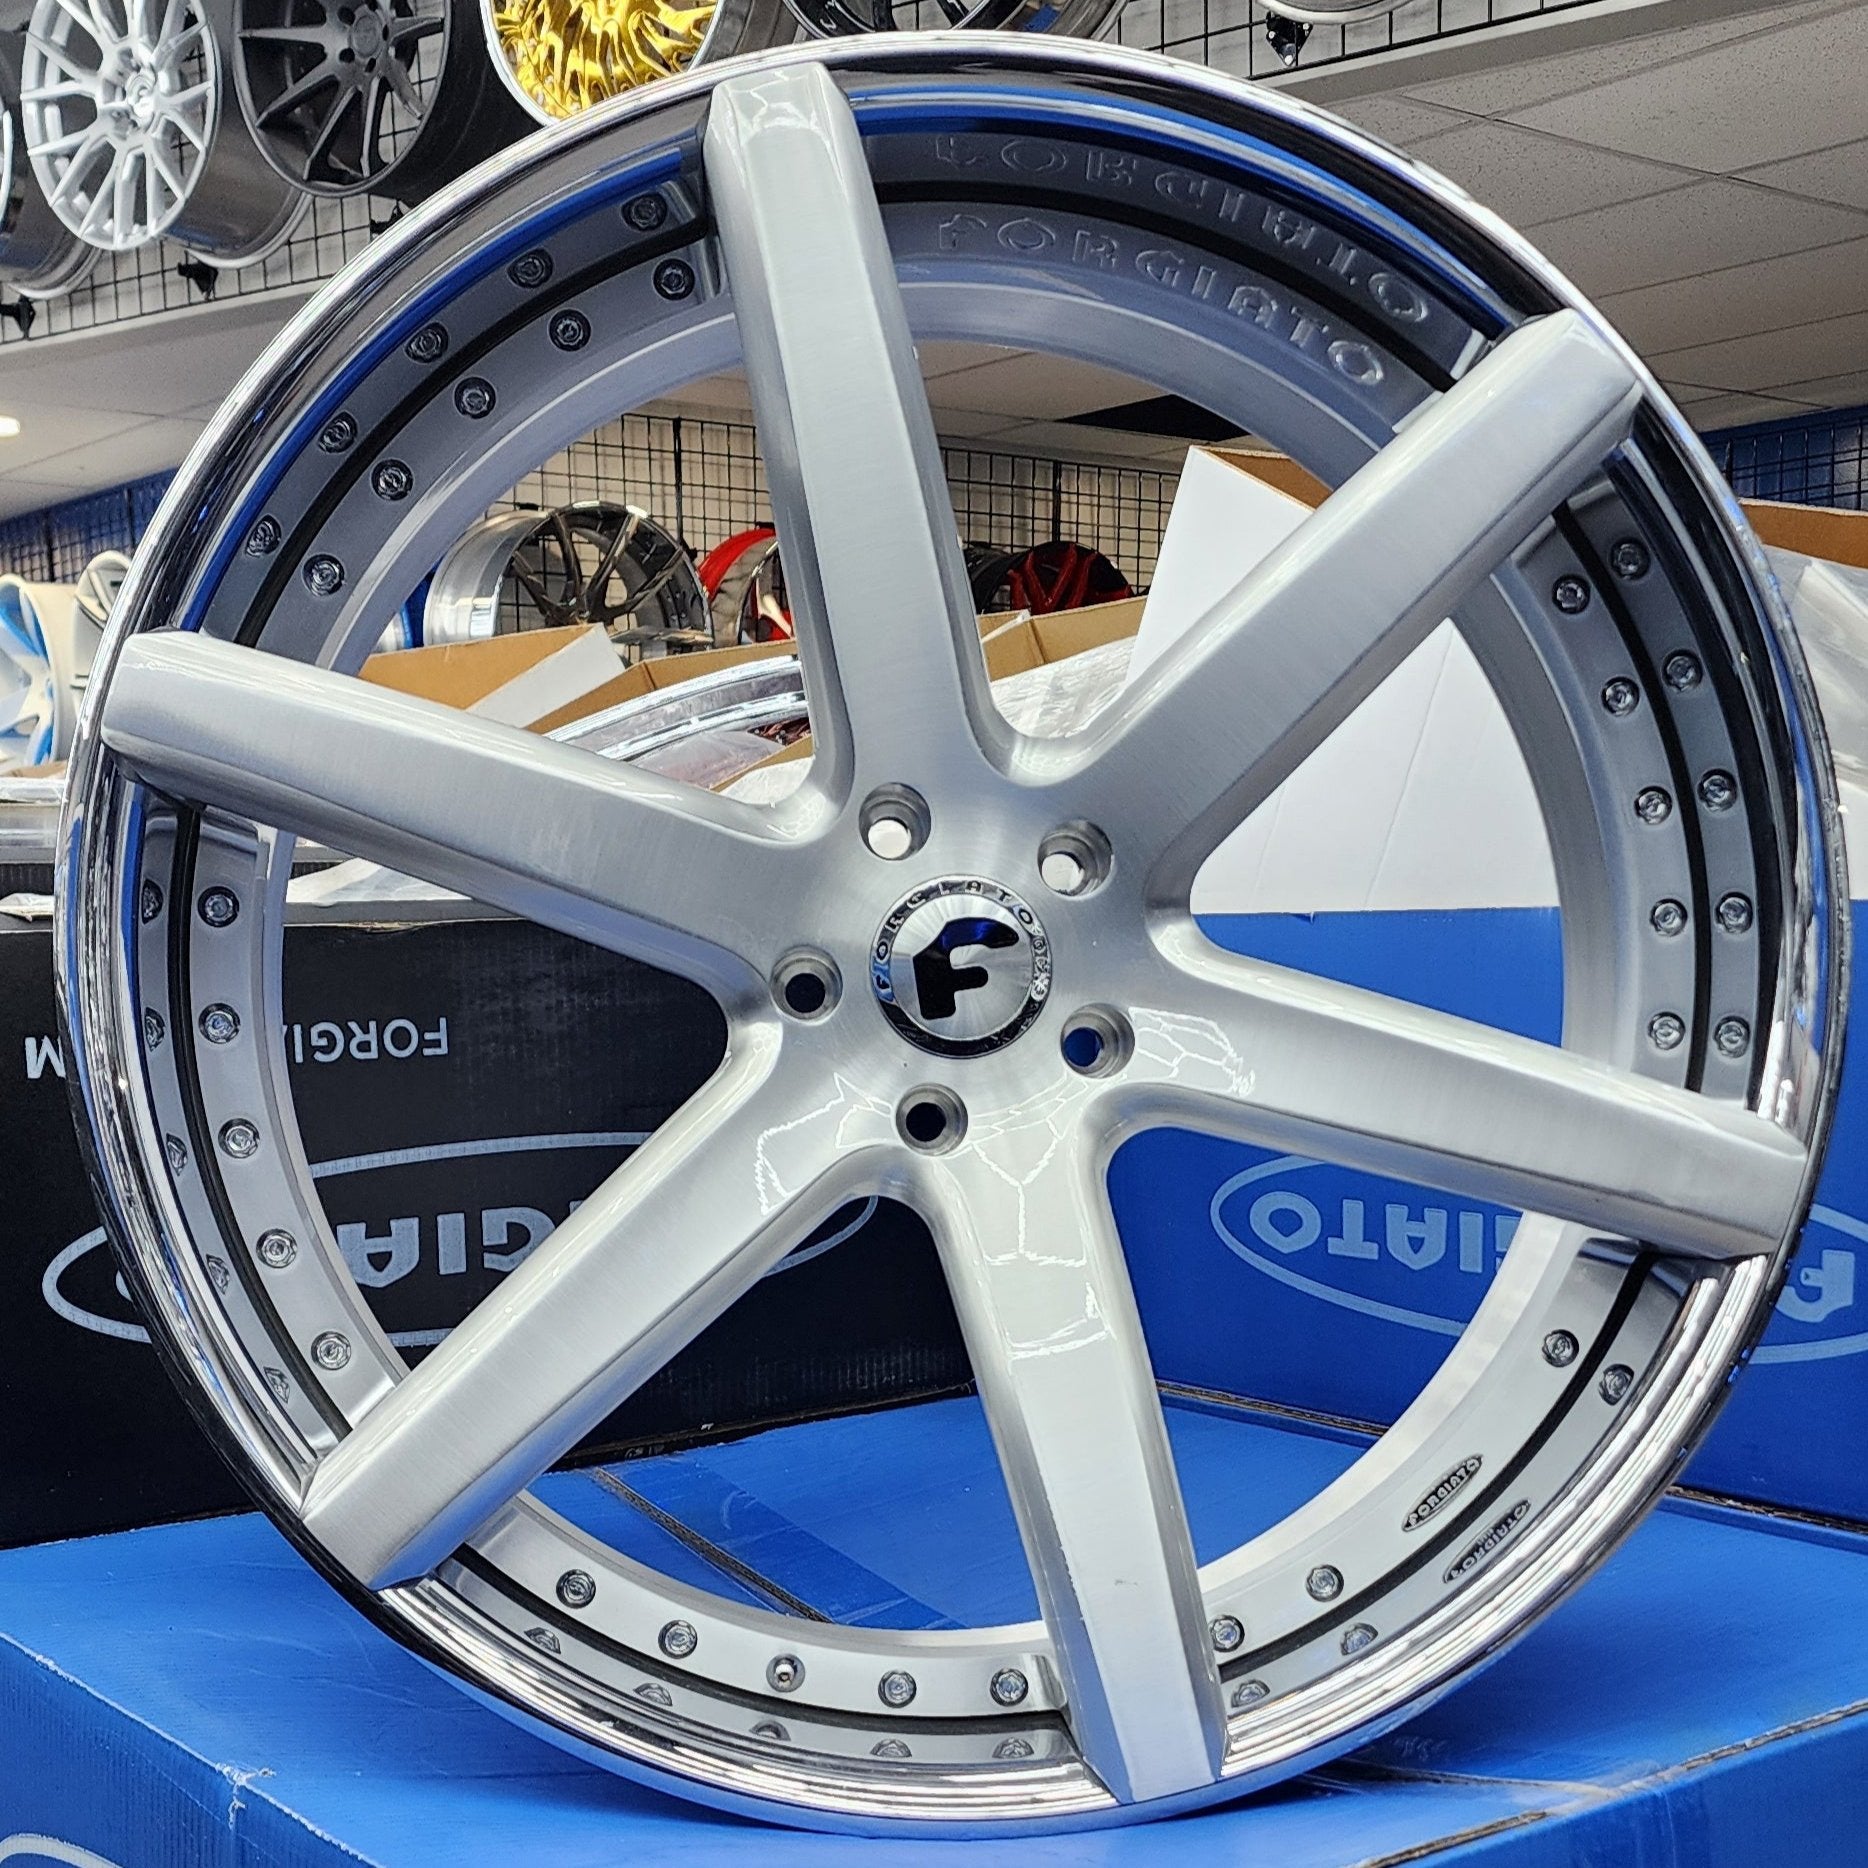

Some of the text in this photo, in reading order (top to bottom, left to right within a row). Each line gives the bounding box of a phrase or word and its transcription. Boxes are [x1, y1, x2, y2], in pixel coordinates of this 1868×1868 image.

[939, 214, 1384, 386] FORGIATO
[283, 1017, 449, 1063] FORGI
[1406, 1457, 1481, 1527] FORGIATO
